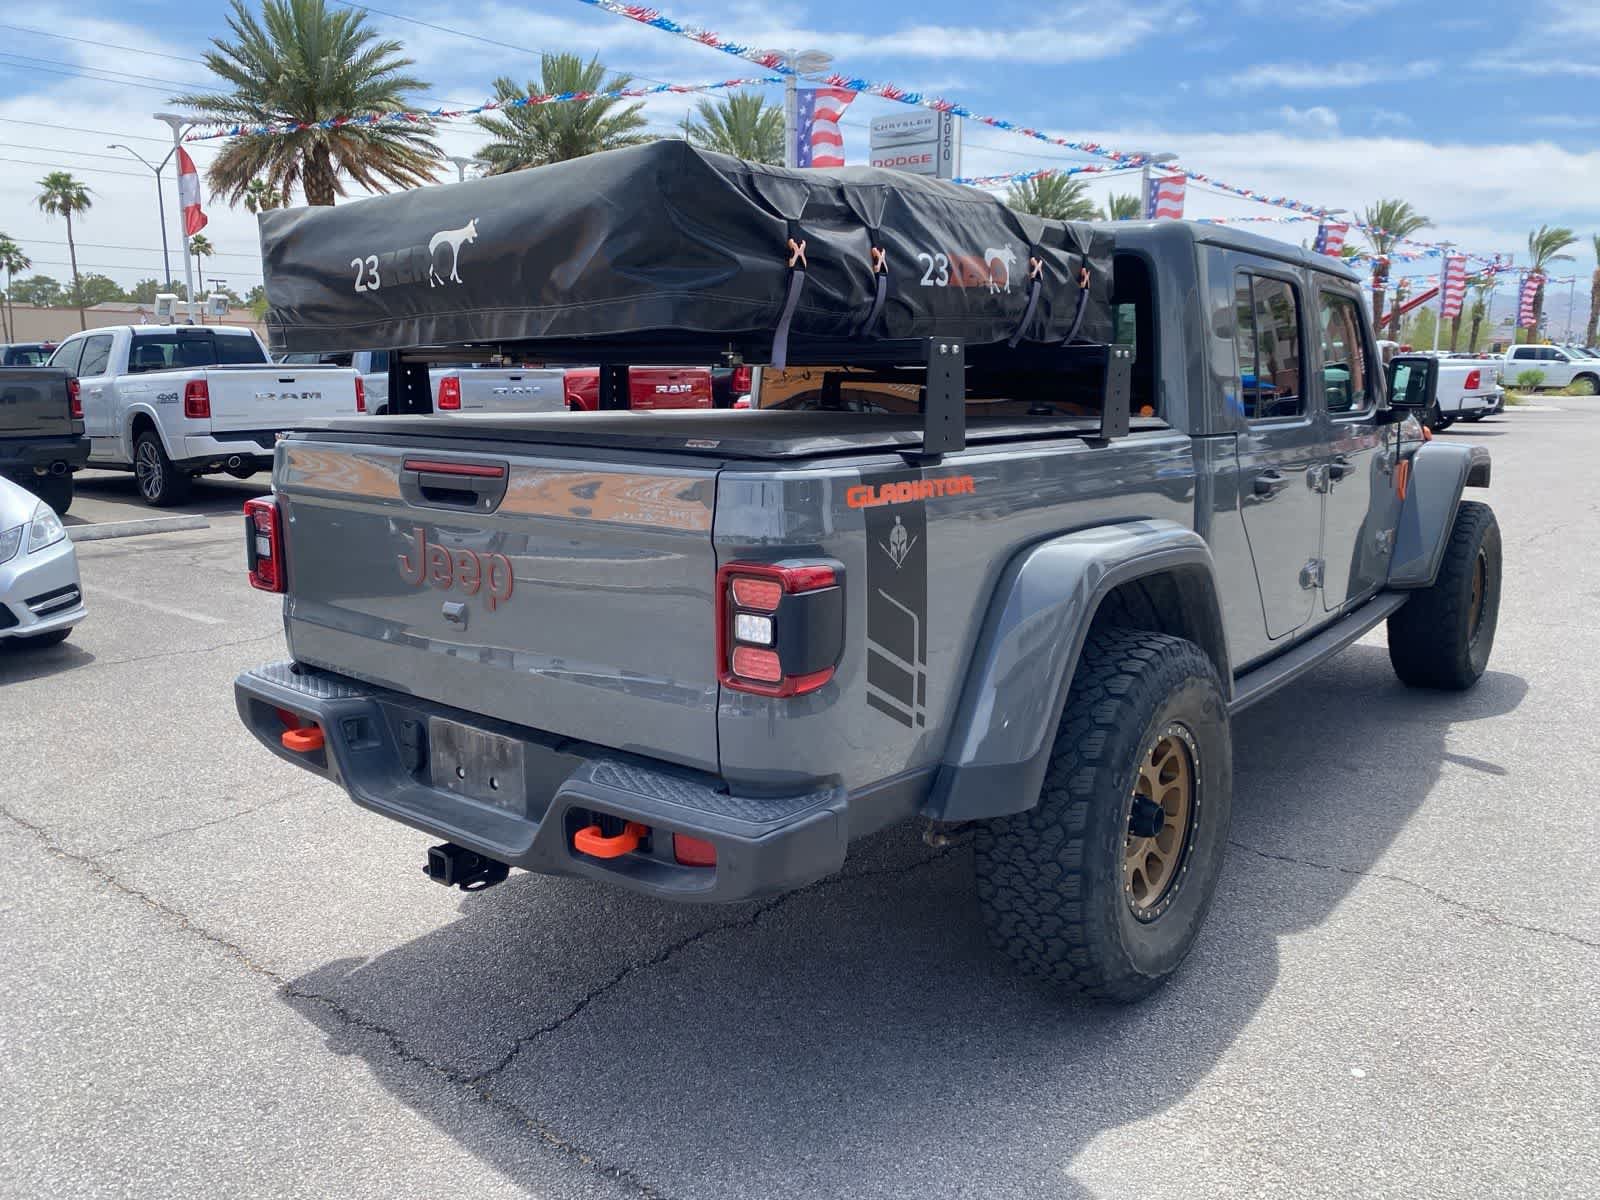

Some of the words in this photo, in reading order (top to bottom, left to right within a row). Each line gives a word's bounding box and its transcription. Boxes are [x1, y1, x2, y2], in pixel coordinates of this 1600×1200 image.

[873, 119, 932, 132] CHRYSLER
[872, 153, 933, 168] DODGE
[255, 391, 322, 401] RAM
[655, 384, 693, 394] RAM
[846, 475, 977, 509] GLADIATOR
[397, 527, 514, 612] Jeep
